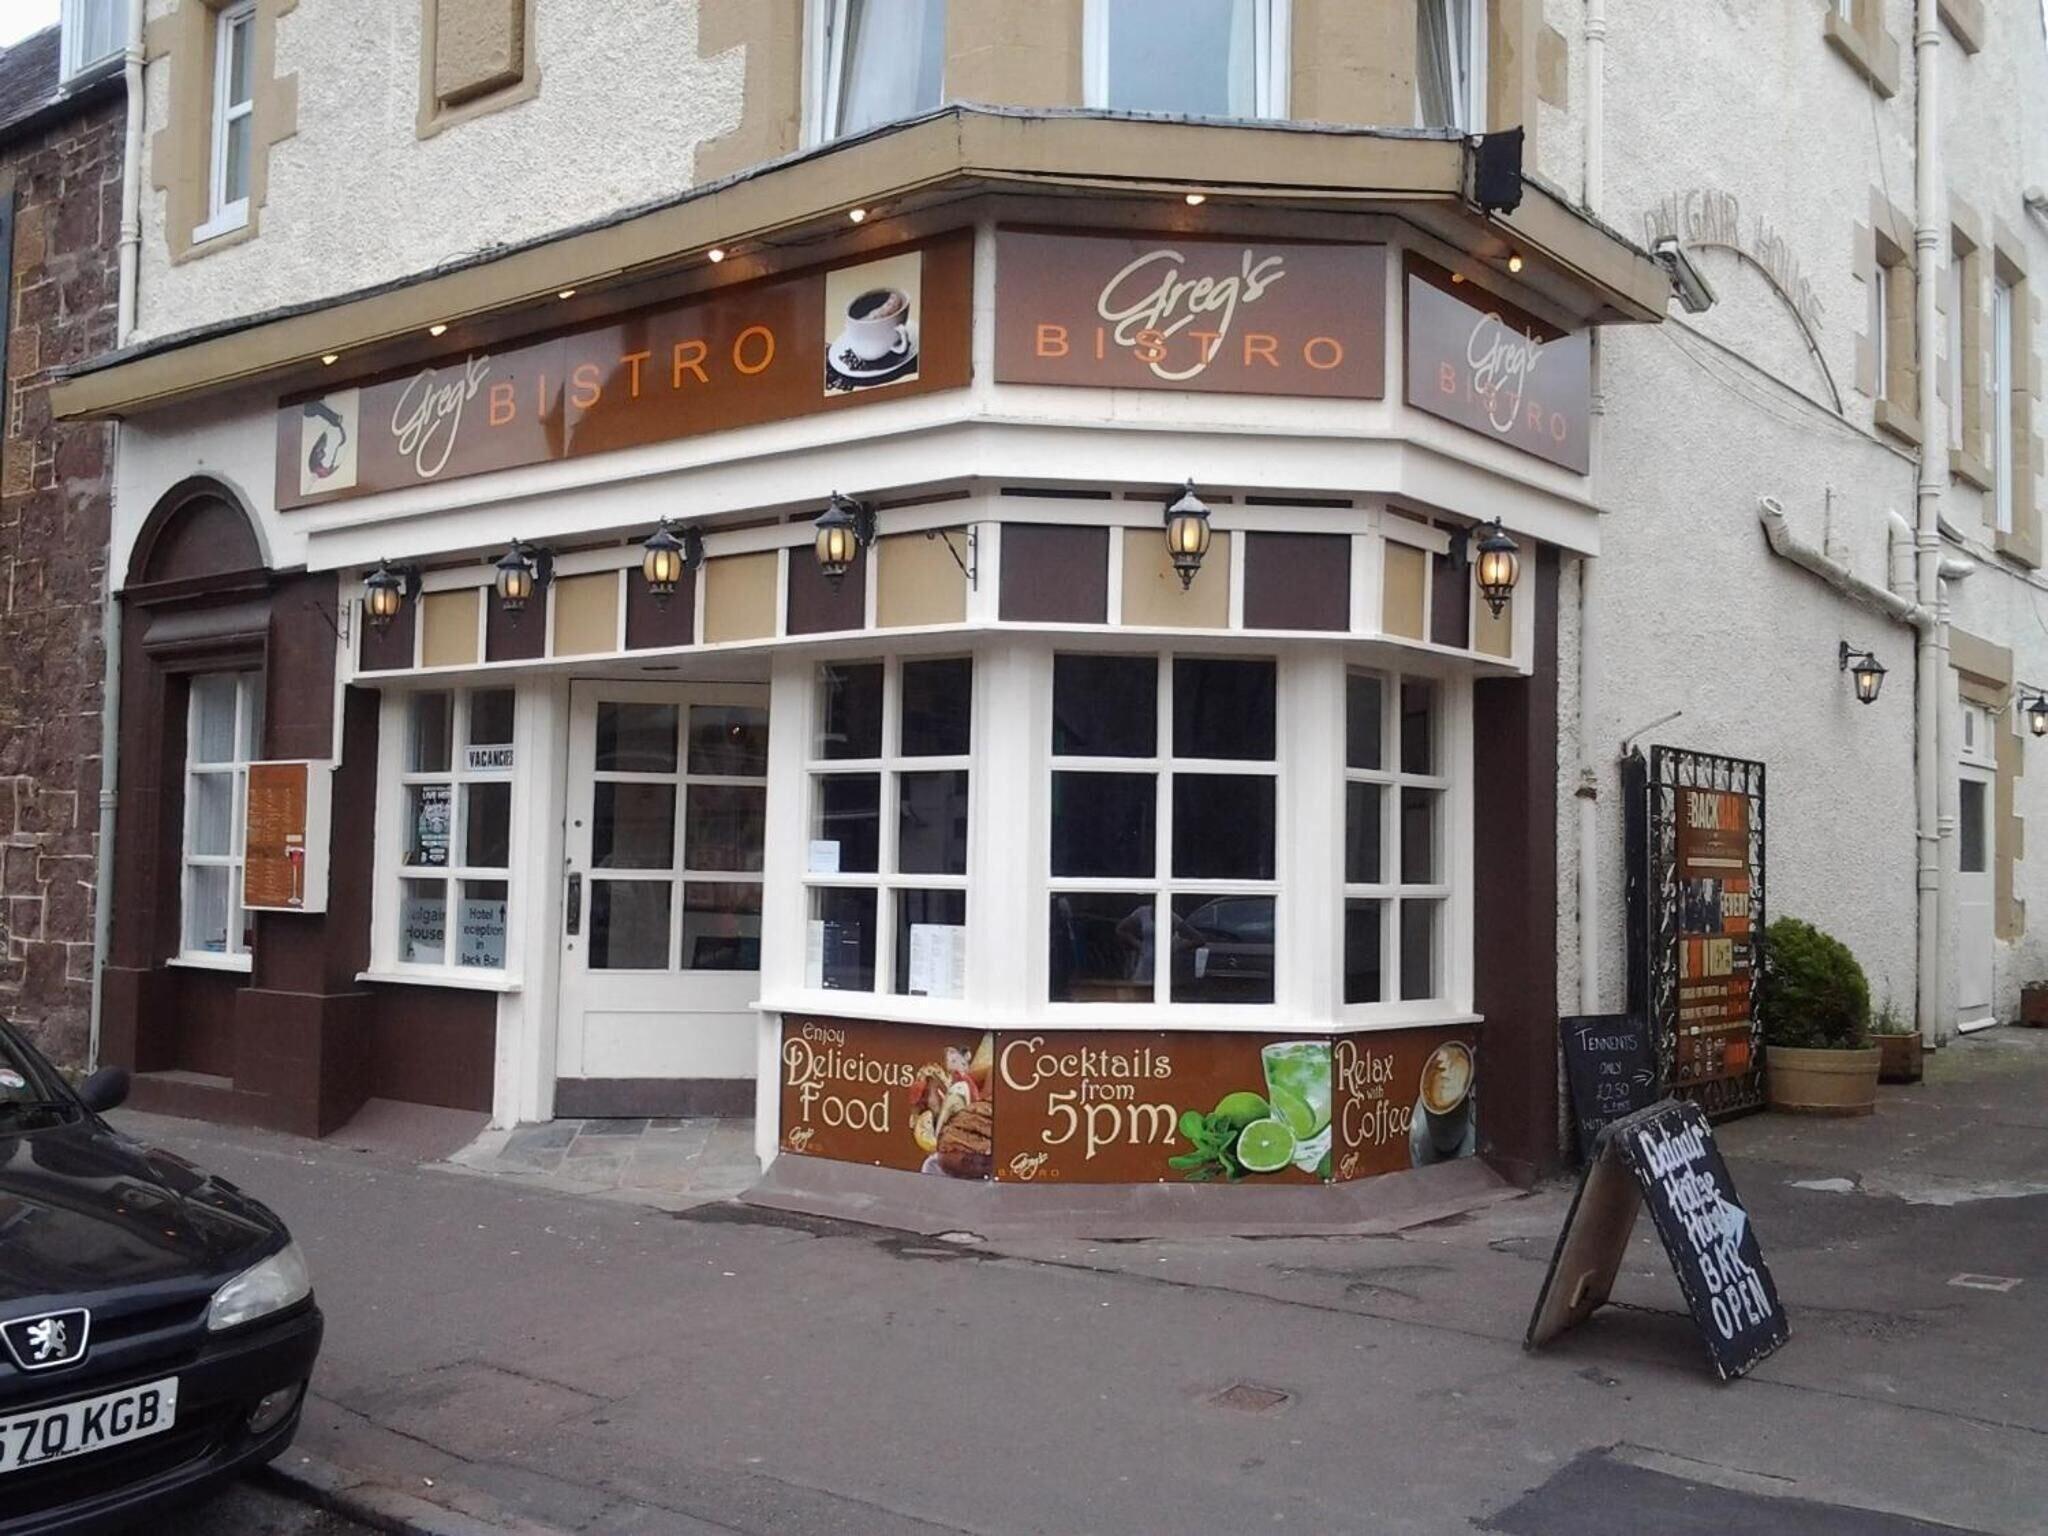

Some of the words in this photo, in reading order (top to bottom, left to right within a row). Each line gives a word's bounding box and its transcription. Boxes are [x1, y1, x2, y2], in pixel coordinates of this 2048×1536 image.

[1097, 249, 1286, 380] Greg's
[1036, 324, 1344, 370] BISTRO
[1467, 312, 1544, 432] Greg's
[392, 353, 490, 477] Greg's
[489, 325, 776, 425] BISTRO
[1439, 361, 1566, 441] BISTRO
[1691, 791, 1720, 829] BACK
[802, 1022, 846, 1047] Enjoy
[783, 1037, 915, 1088] Delicious
[1000, 1036, 1173, 1091] Cocktails
[1335, 1040, 1394, 1101] Relax
[799, 1079, 890, 1132] Food
[1081, 1078, 1135, 1105] from
[1365, 1083, 1385, 1100] with
[1041, 1089, 1178, 1160] 5pm
[1343, 1097, 1415, 1147] Coffee
[1010, 1152, 1049, 1180] Greg's
[1699, 1240, 1751, 1295] BAR
[1710, 1267, 1773, 1340] OPEN
[82, 1389, 160, 1446] KGB
